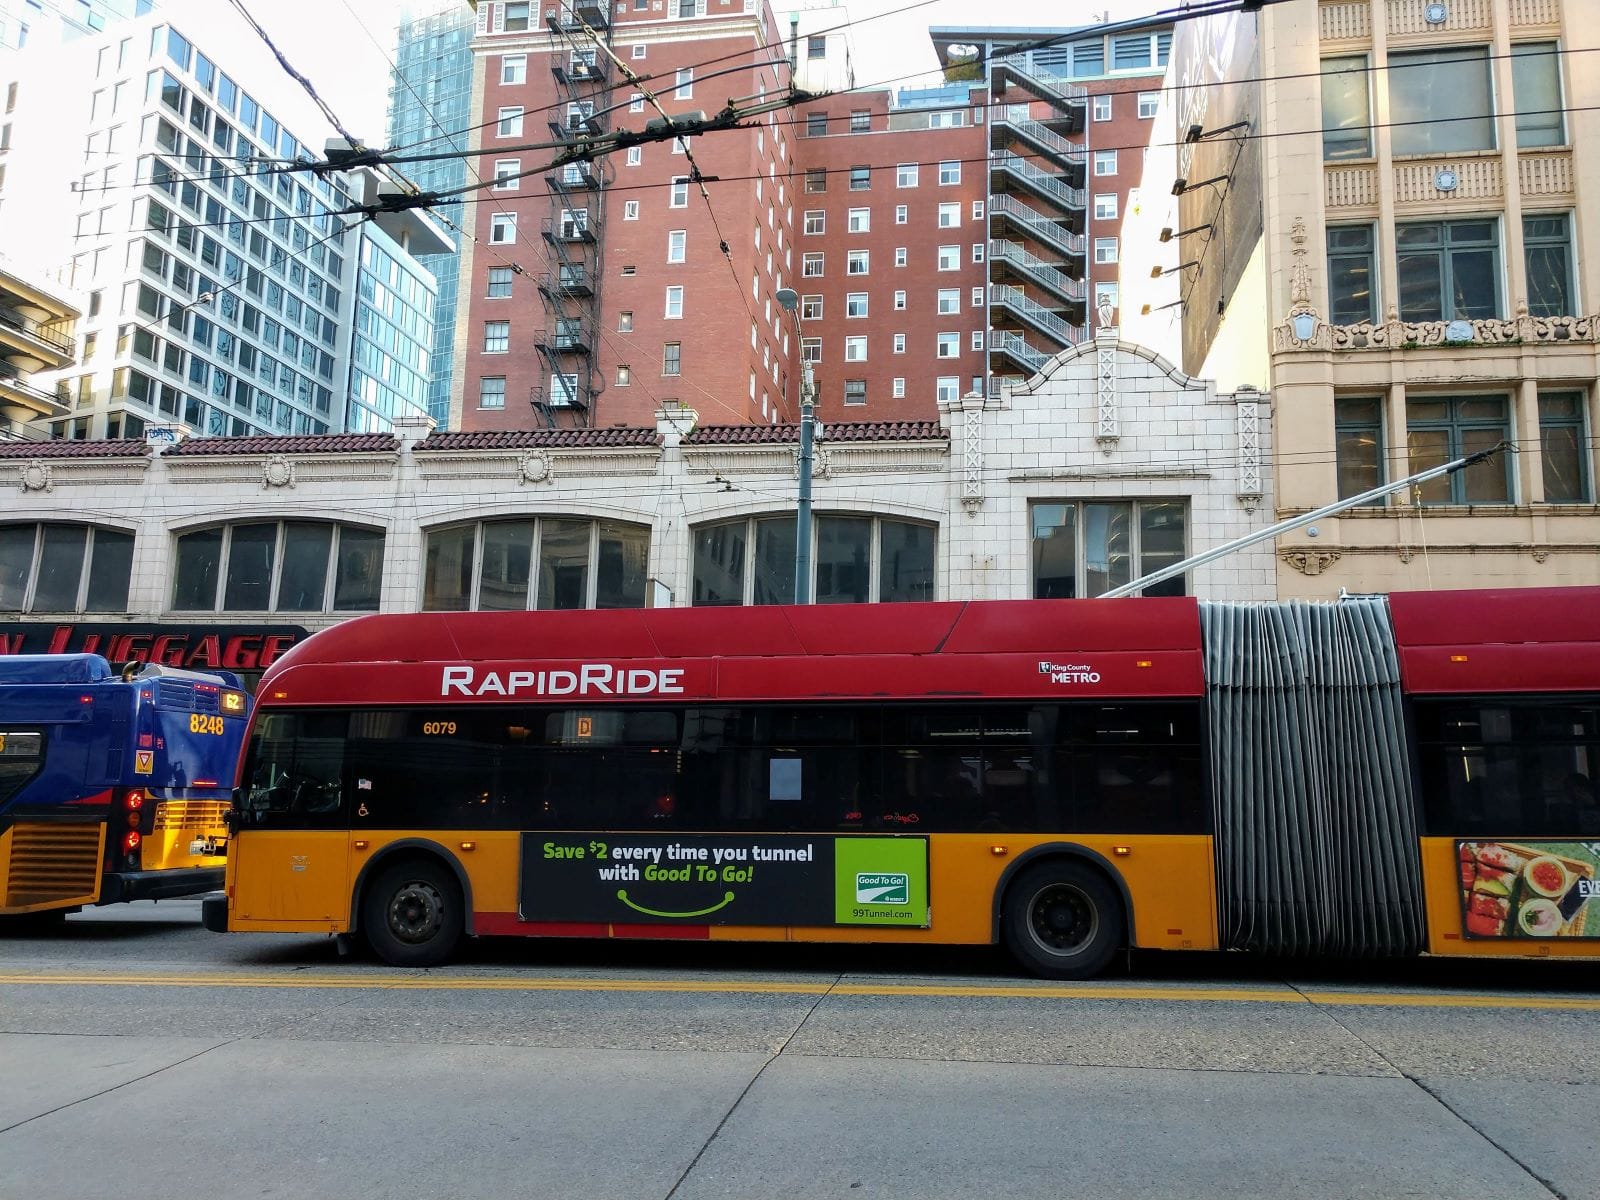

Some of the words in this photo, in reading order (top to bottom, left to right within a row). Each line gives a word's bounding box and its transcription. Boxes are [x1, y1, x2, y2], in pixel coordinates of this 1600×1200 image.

[441, 664, 685, 696] RAPIDRIDE
[1051, 672, 1101, 683] METRO
[190, 713, 224, 735] 8248
[423, 722, 457, 735] 6079
[579, 719, 591, 735] D
[543, 842, 585, 859] Save
[589, 840, 608, 859] $2
[612, 847, 662, 864] every
[666, 843, 708, 860] time
[713, 848, 747, 864] you
[752, 844, 813, 861] tunnel
[598, 864, 639, 881] with
[644, 864, 691, 882] Good
[696, 865, 717, 882] To
[722, 865, 754, 883] Go!
[859, 876, 880, 885] Good
[880, 877, 889, 885] To
[890, 877, 904, 886] Go!
[852, 908, 913, 919] 99Tunnel.com
